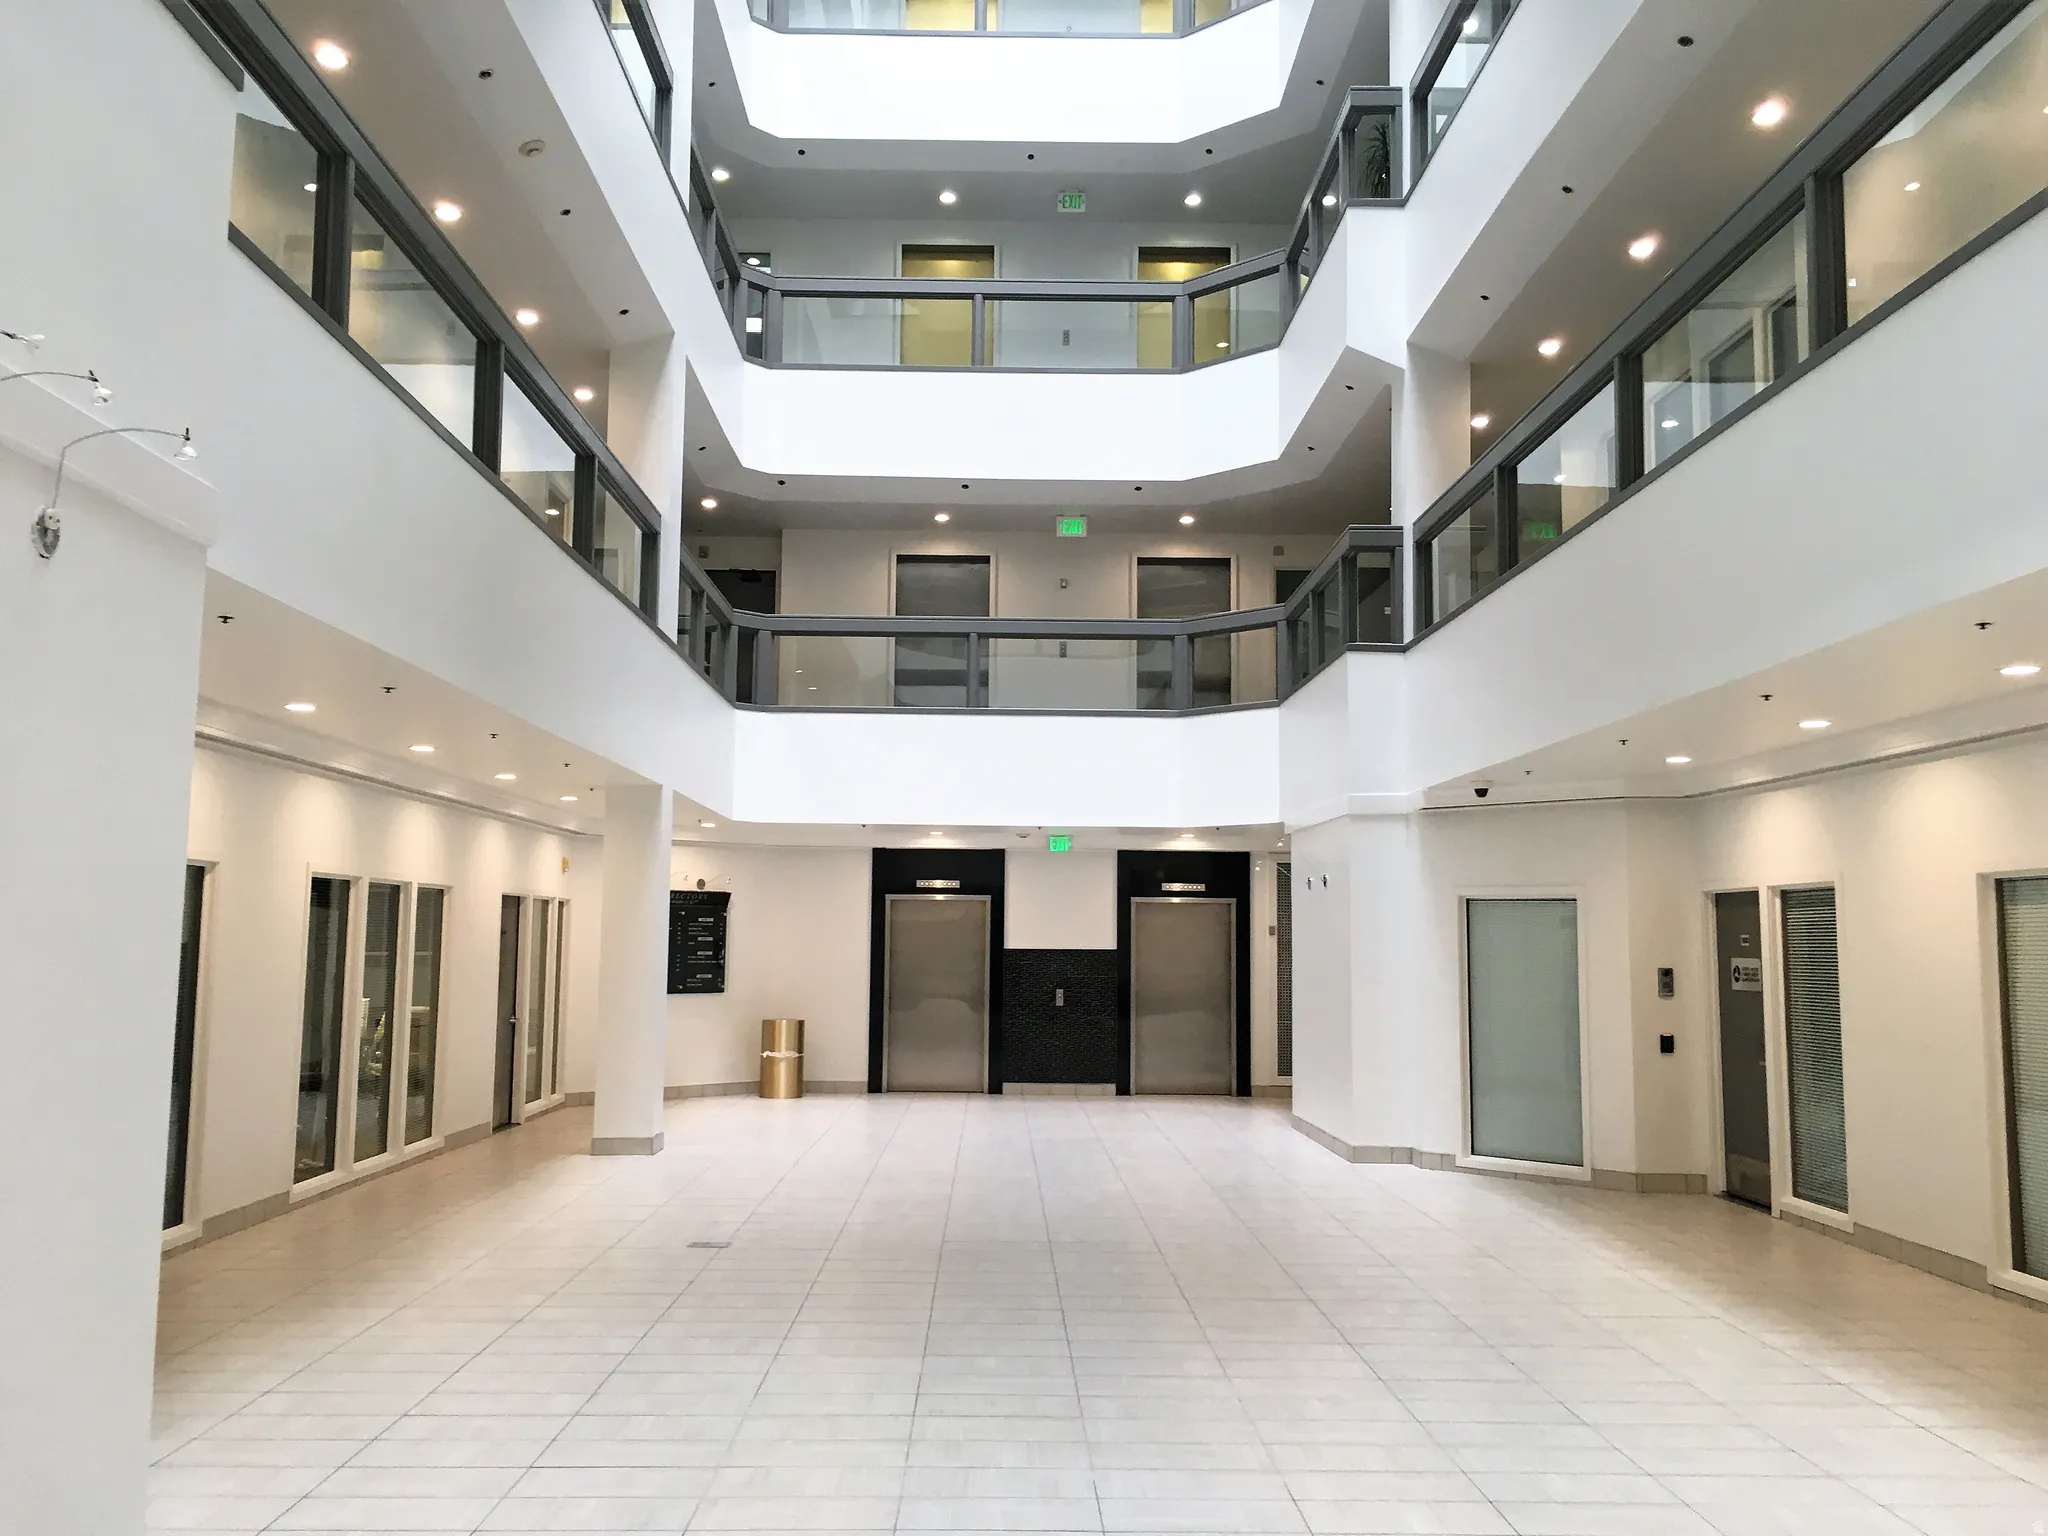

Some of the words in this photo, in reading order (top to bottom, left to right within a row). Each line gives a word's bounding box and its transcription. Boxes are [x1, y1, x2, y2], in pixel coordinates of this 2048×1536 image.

[1062, 194, 1083, 209] EXIT
[1061, 519, 1083, 535] EXIT
[1049, 836, 1069, 852] EXIT
